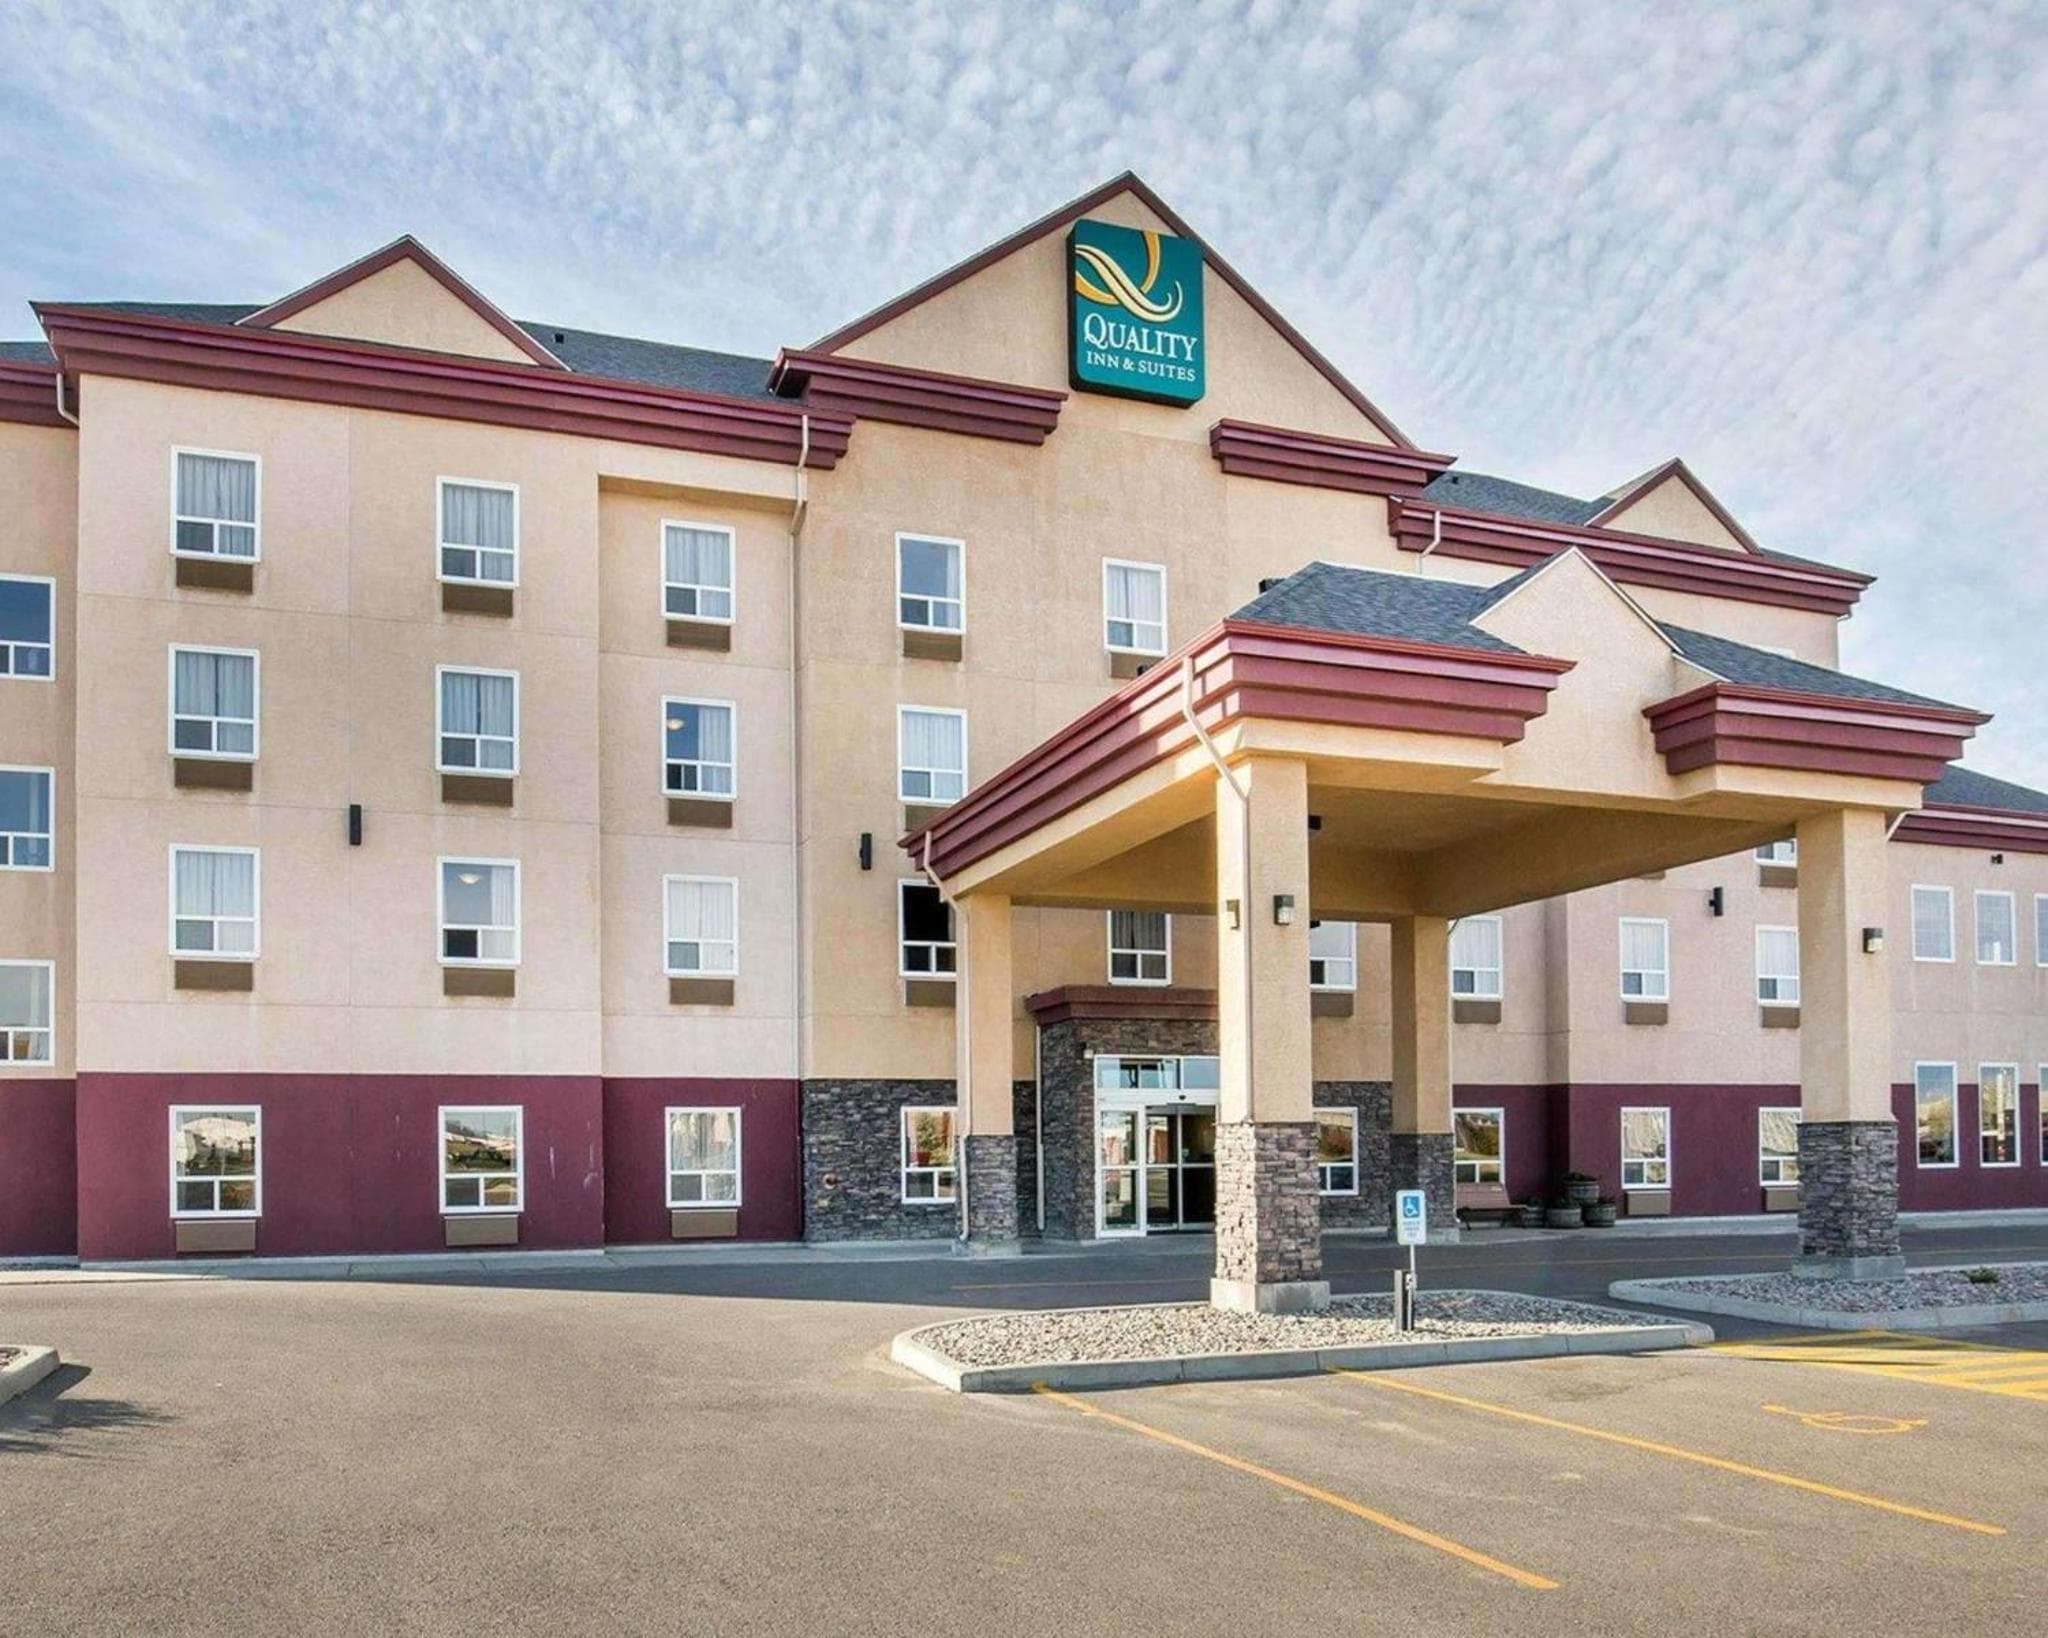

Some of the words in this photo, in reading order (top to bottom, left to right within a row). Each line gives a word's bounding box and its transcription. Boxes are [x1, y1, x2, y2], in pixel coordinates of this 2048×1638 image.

[1084, 313, 1198, 361] QUALITY
[1086, 351, 1119, 369] INN
[1122, 358, 1135, 371] &
[1138, 361, 1196, 382] SUITES
